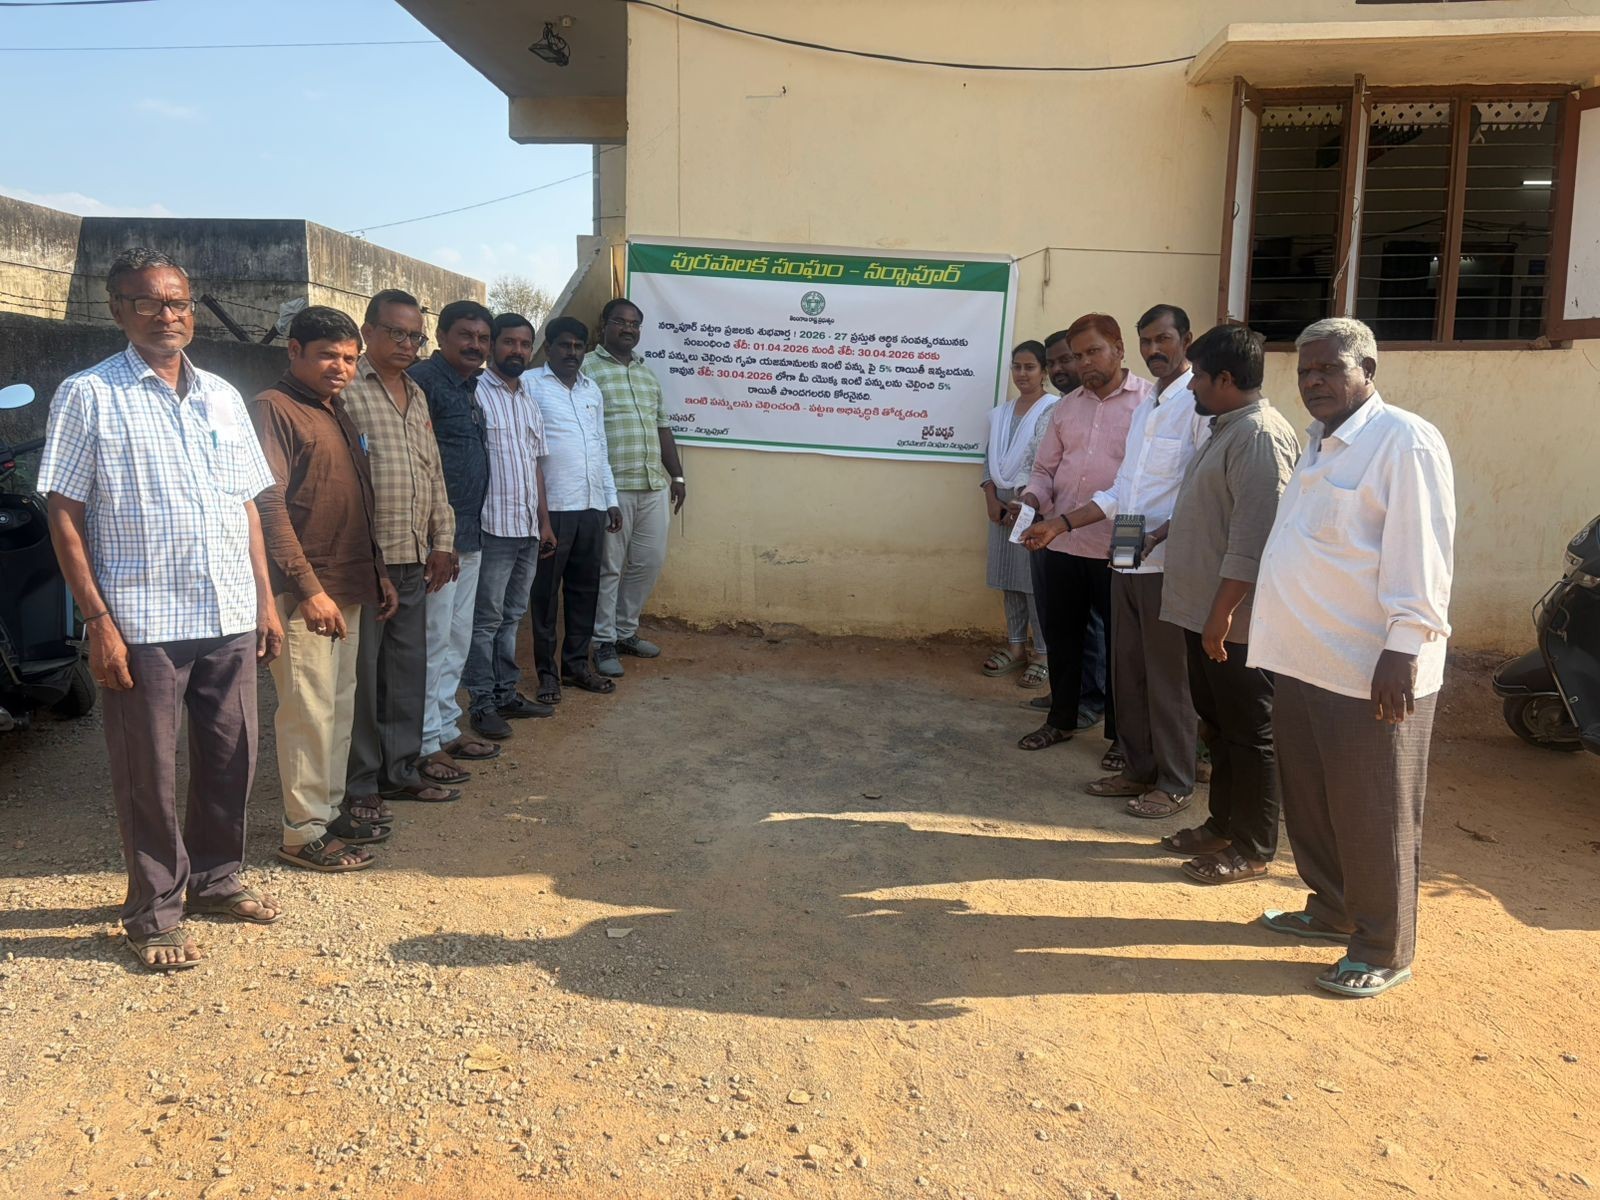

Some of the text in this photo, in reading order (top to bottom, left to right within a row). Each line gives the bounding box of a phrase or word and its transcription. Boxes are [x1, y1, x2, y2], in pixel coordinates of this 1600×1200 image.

[670, 252, 770, 272] పురపాలక
[771, 258, 844, 279] సంఘం
[864, 263, 965, 286] నర్సాపూర్
[700, 324, 722, 336] పట్టణ
[724, 326, 754, 336] ప్రజలకు
[756, 327, 791, 340] శుభవార్త
[799, 330, 826, 340] 2026
[834, 332, 848, 340] 27
[850, 333, 876, 345] ప్రస్తుత
[684, 338, 730, 348] సంబంధించి
[753, 343, 809, 353] 01.04.2026
[812, 345, 834, 354] నుండి
[858, 348, 915, 359] 30.04.2026
[918, 352, 940, 360] వరకు
[644, 350, 666, 358] ఇంటి
[668, 351, 698, 363] పన్నులు
[701, 353, 732, 365] చెల్లించు
[736, 356, 756, 368] గృహ
[759, 357, 818, 368] యజమానులకు
[820, 360, 842, 370] ఇంటి
[844, 362, 865, 374] పన్ను
[868, 364, 876, 374] పై
[878, 364, 892, 373] 5%
[895, 364, 925, 374] రాయితీ
[670, 366, 694, 376] కావున
[716, 370, 772, 380] 30.04.2026
[776, 371, 796, 382] లోగా
[798, 373, 808, 382] మీ
[812, 375, 838, 386] యొక్క
[841, 377, 862, 386] ఇంటి
[864, 378, 902, 390] పన్నులను
[905, 380, 934, 392] చెల్లించి
[938, 382, 951, 390] 5%
[748, 385, 777, 394] రాయితీ
[780, 387, 831, 399] పొందగలరని
[684, 396, 708, 405] ఇంటి
[710, 398, 752, 410] పన్నులను
[808, 404, 834, 417] పట్టణ
